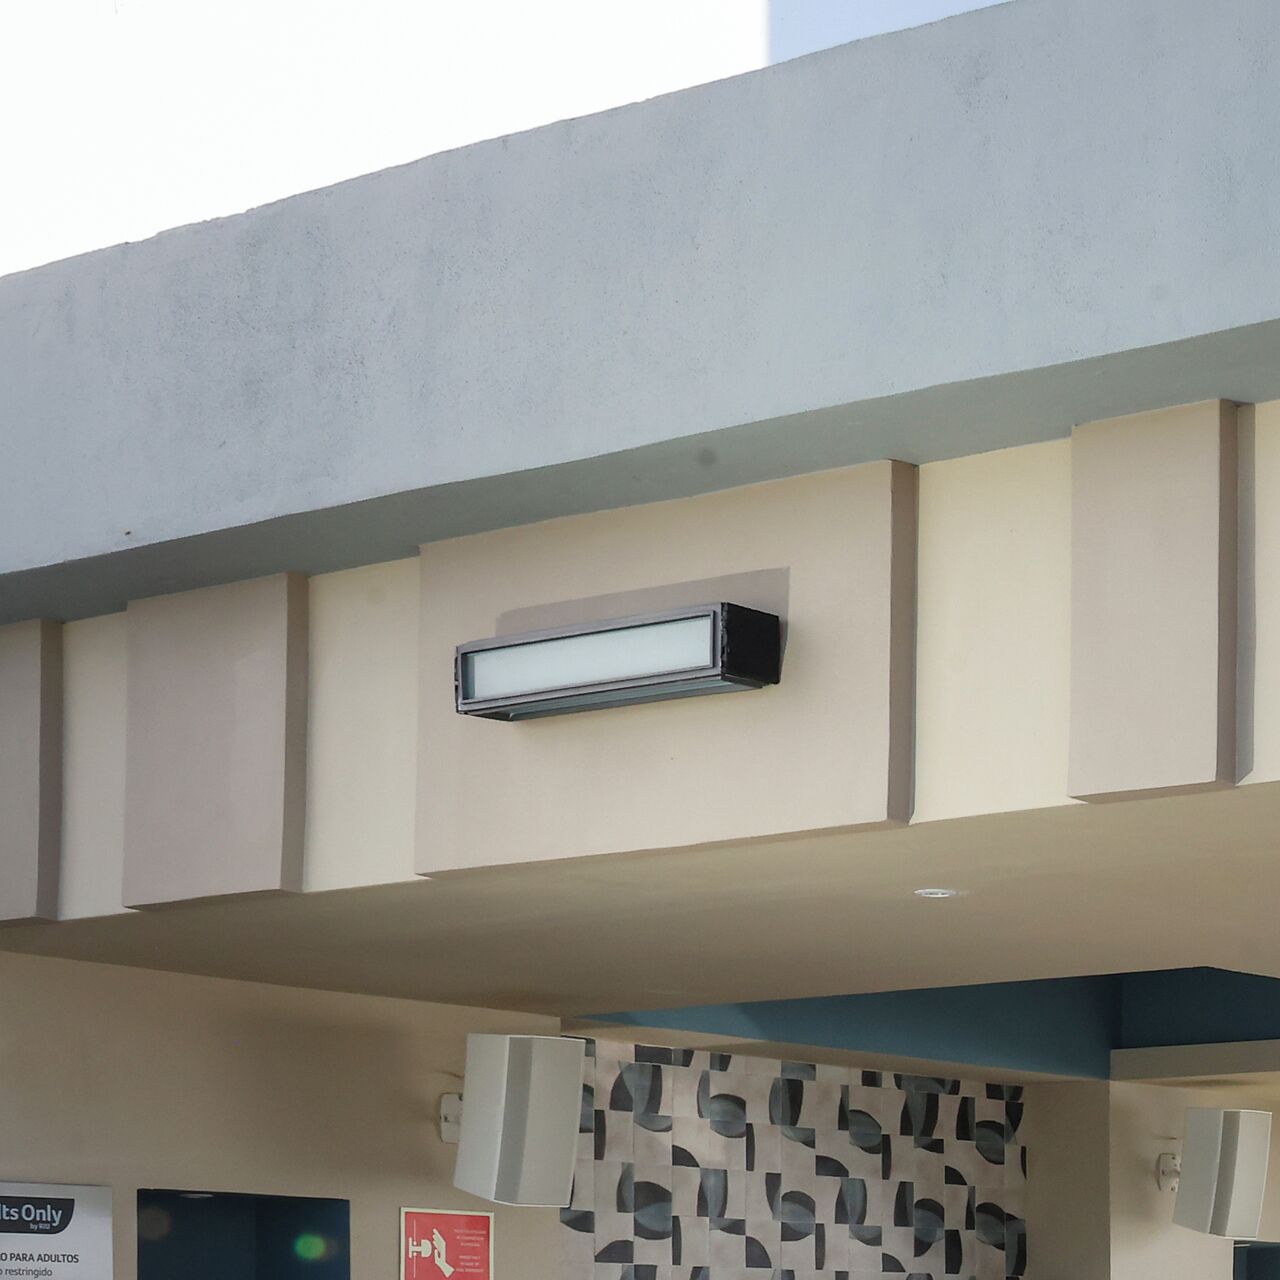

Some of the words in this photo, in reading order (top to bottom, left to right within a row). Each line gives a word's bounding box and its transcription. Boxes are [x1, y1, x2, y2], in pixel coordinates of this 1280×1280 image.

[21, 1204, 62, 1227] Only
[9, 1253, 35, 1262] PARA
[36, 1254, 79, 1264] ADULTOS
[5, 1266, 53, 1279] restringido
